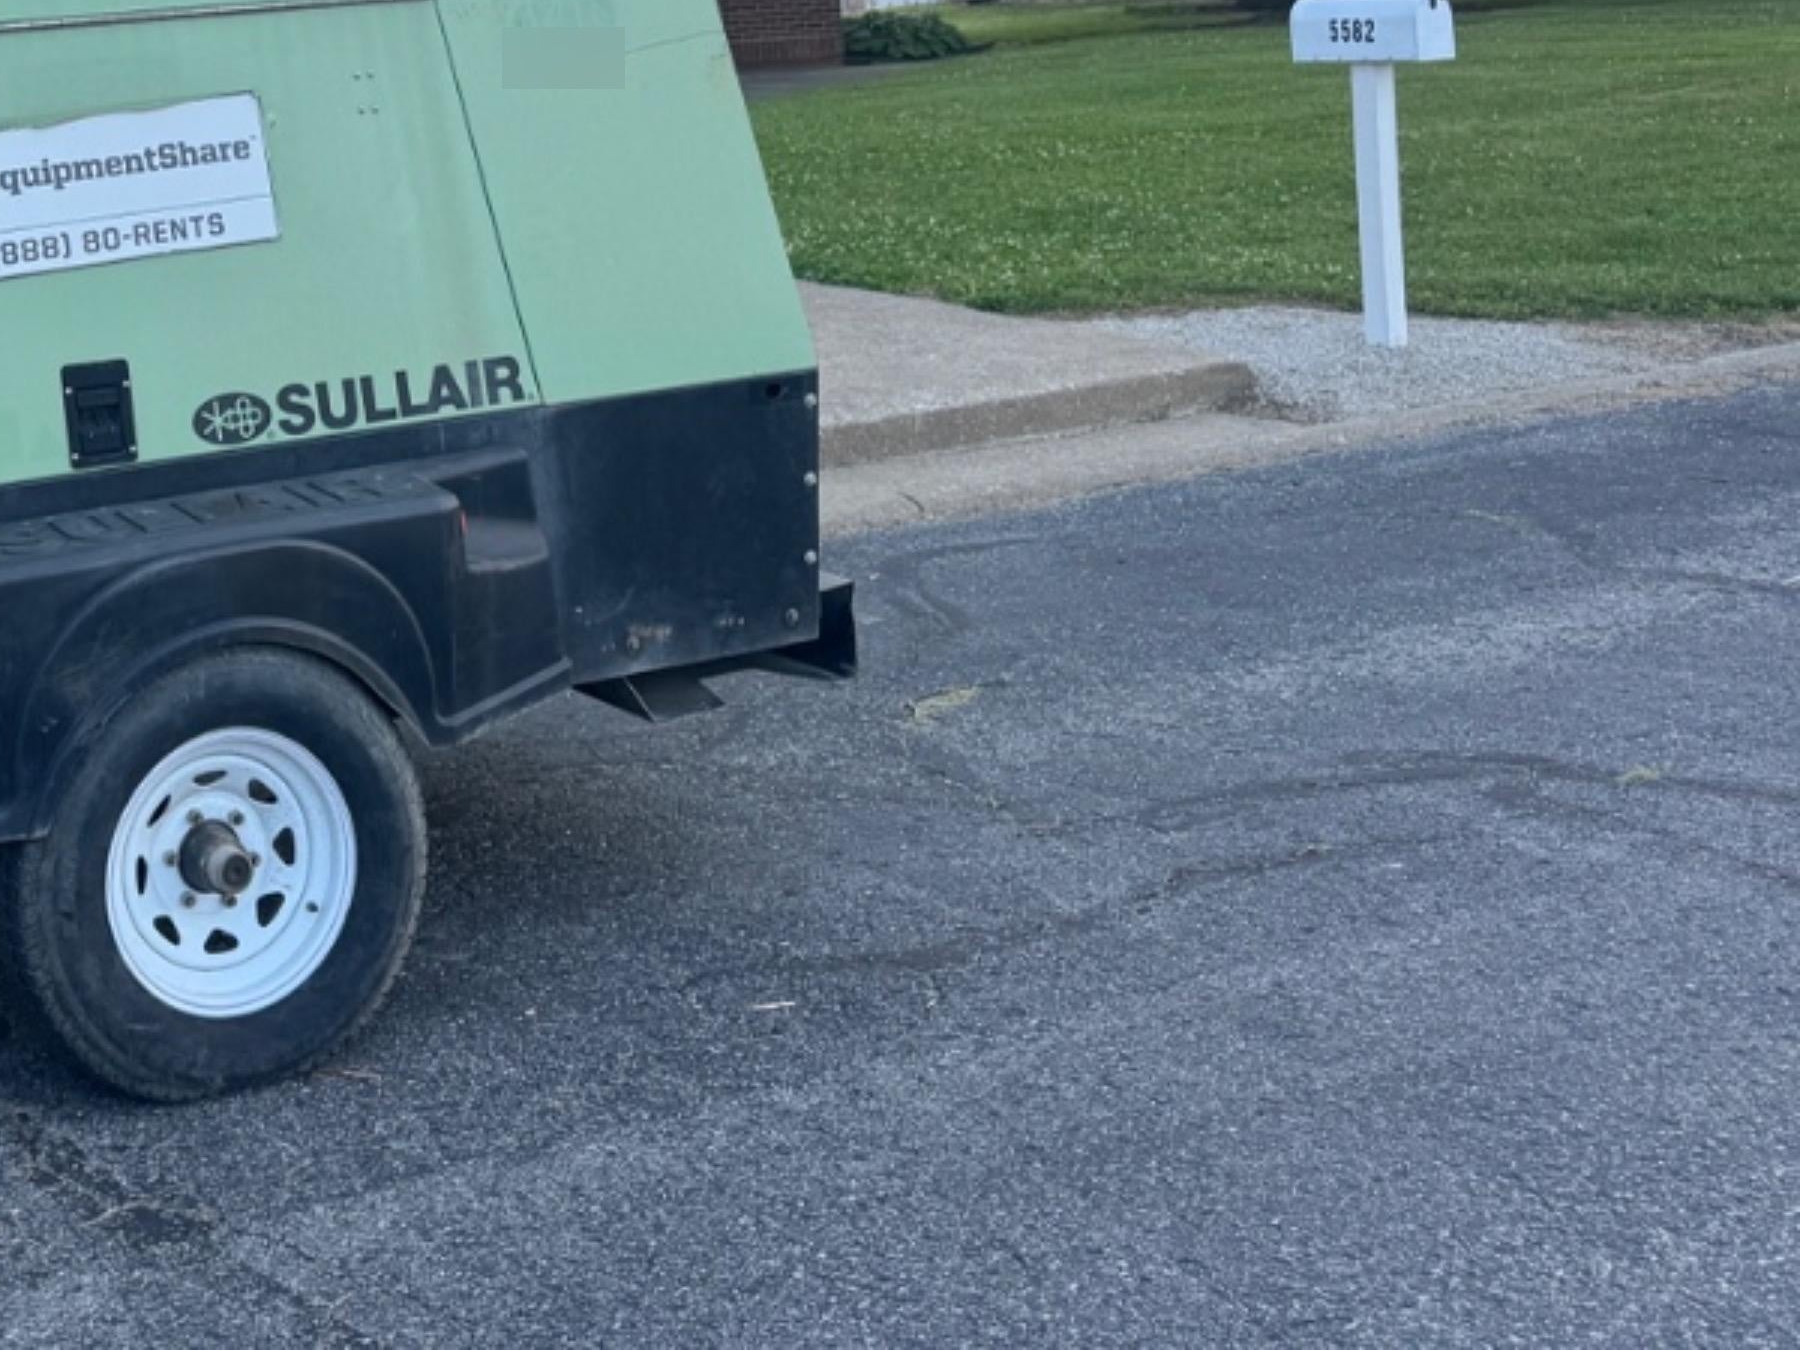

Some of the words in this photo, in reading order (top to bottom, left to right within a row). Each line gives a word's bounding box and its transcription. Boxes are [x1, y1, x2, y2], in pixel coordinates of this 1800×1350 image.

[1328, 17, 1375, 43] 5582
[83, 212, 226, 254] 80-RENTS
[275, 355, 528, 436] SULLAIR
